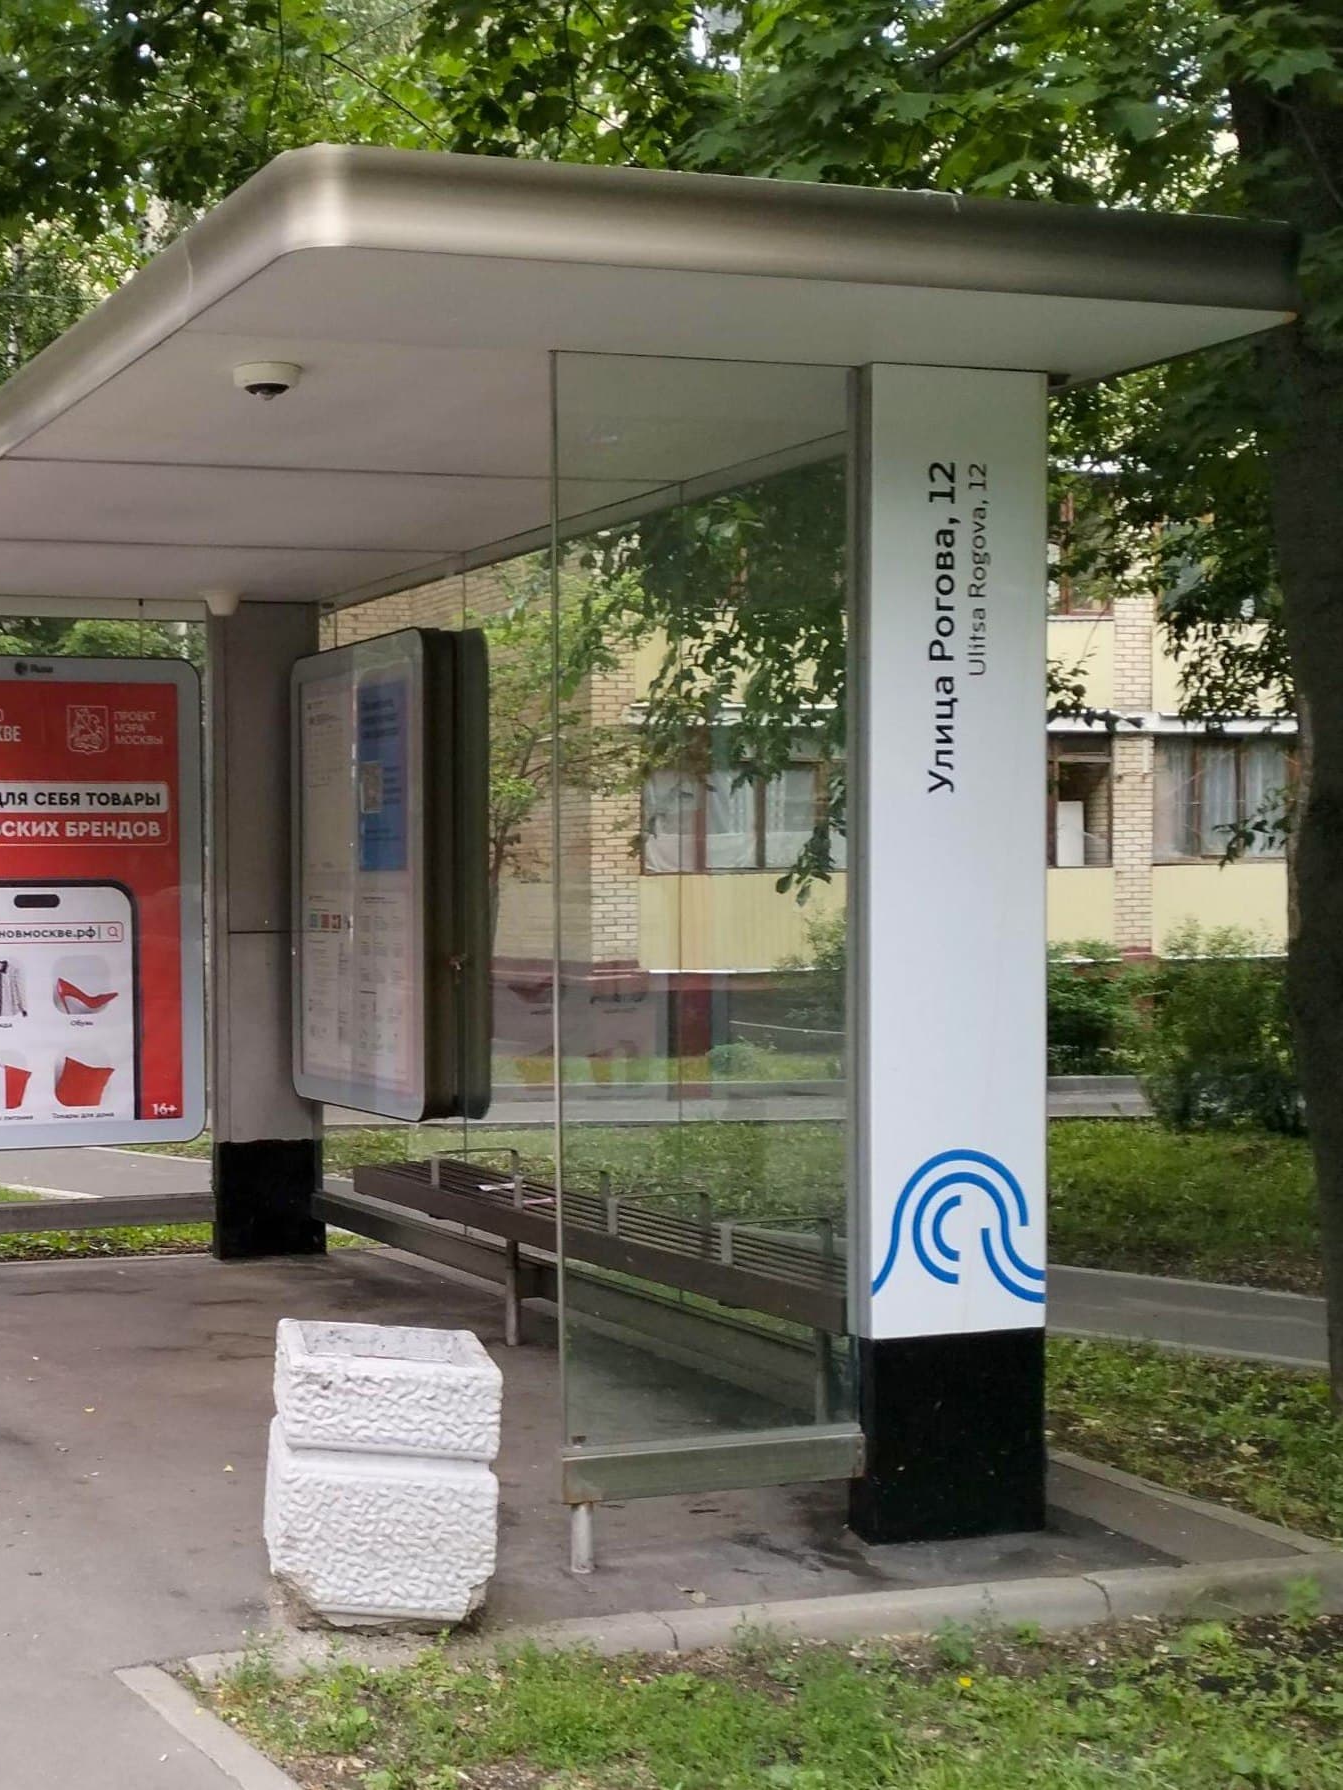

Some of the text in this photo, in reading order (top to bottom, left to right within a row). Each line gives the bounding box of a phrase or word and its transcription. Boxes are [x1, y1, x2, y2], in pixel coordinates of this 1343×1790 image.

[968, 463, 992, 677] Ulitsa Rogova, 12
[928, 461, 961, 793] Улица Рогова, 12
[34, 792, 80, 807] СЕБЯ
[89, 792, 161, 807] ТОВАРЫ
[65, 820, 161, 839] БРЕНДОВ
[152, 1103, 178, 1115] 16+
